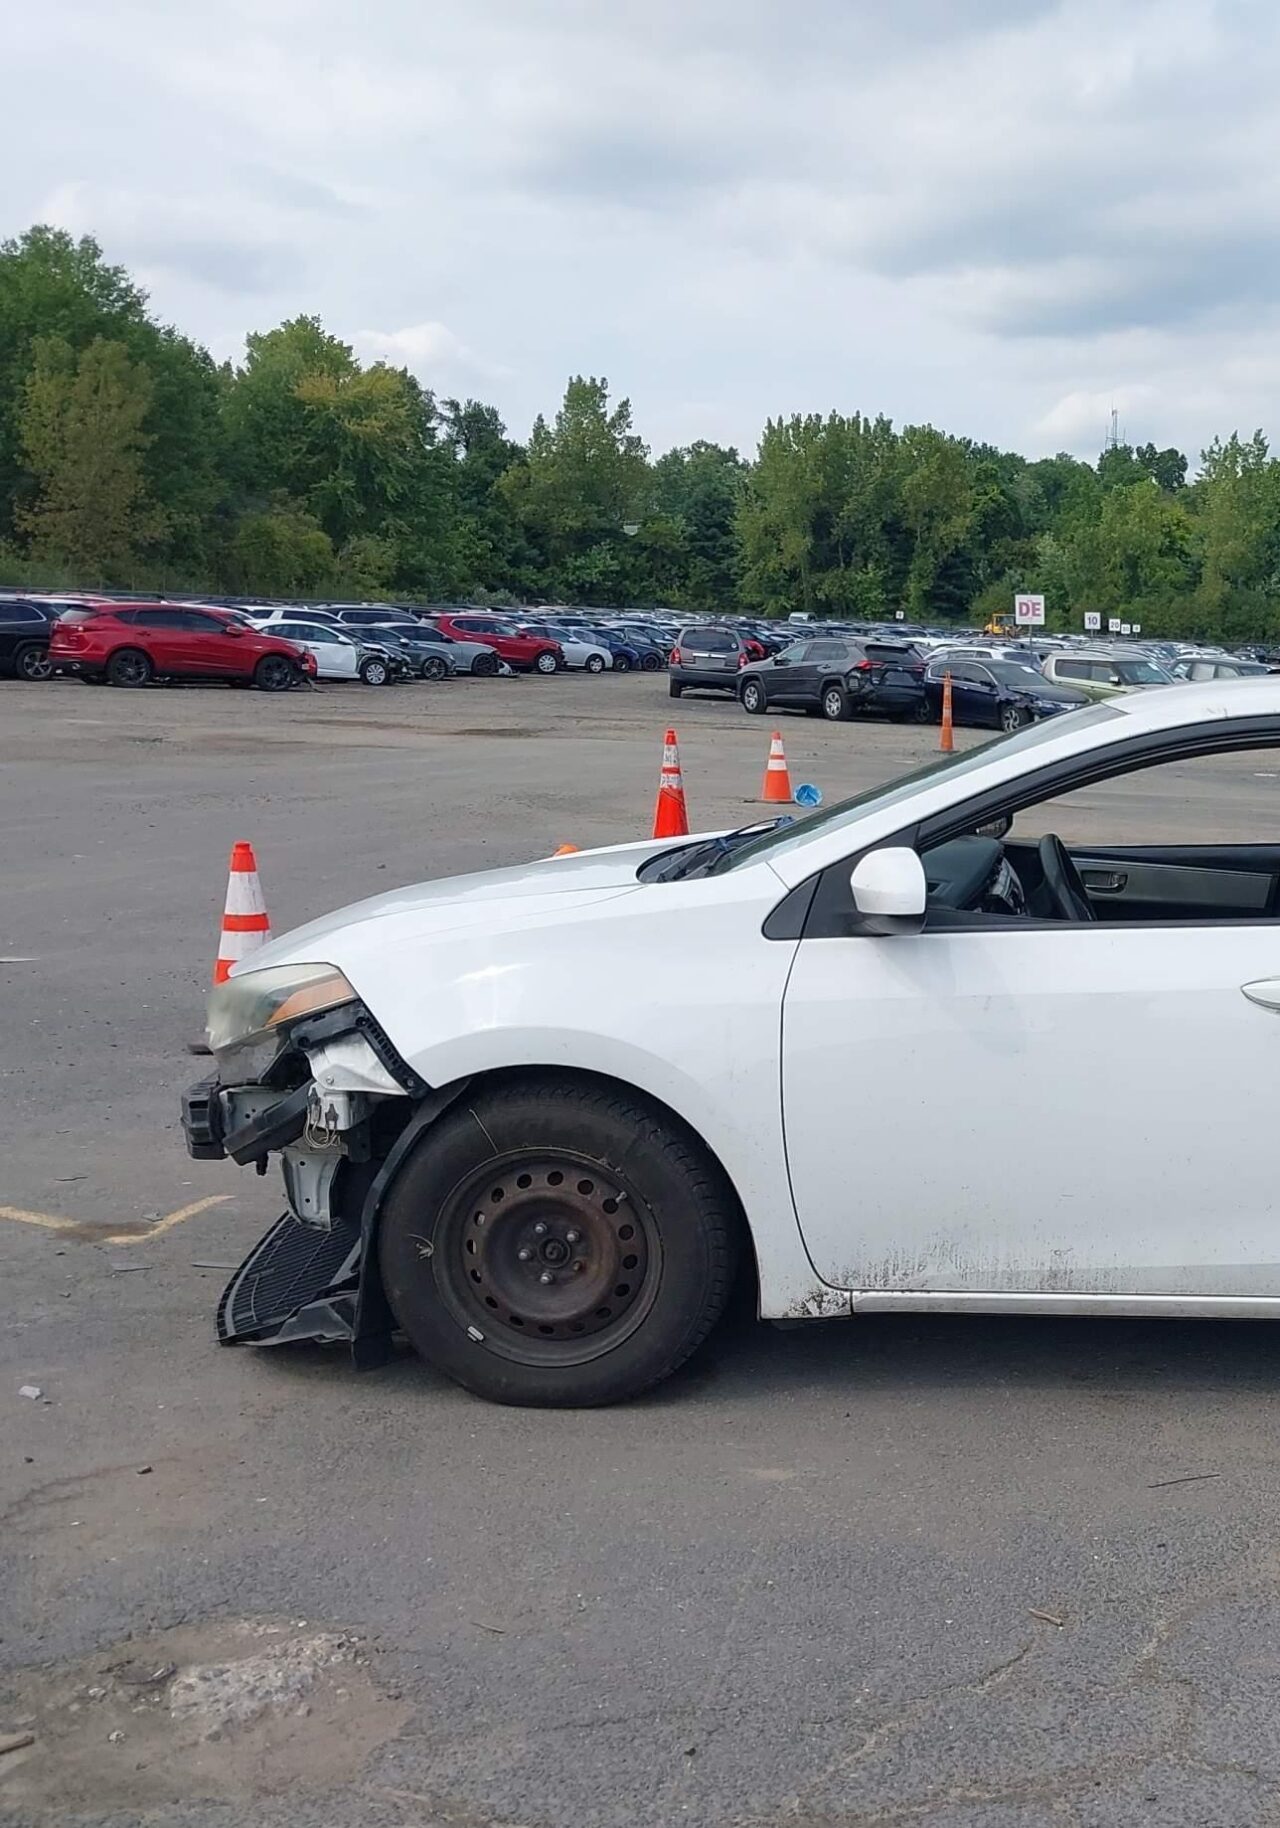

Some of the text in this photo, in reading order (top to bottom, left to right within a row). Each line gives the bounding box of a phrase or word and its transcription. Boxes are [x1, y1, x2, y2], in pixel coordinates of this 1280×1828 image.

[1018, 601, 1041, 617] DE
[1087, 616, 1098, 626] 10
[1110, 621, 1120, 629] 20
